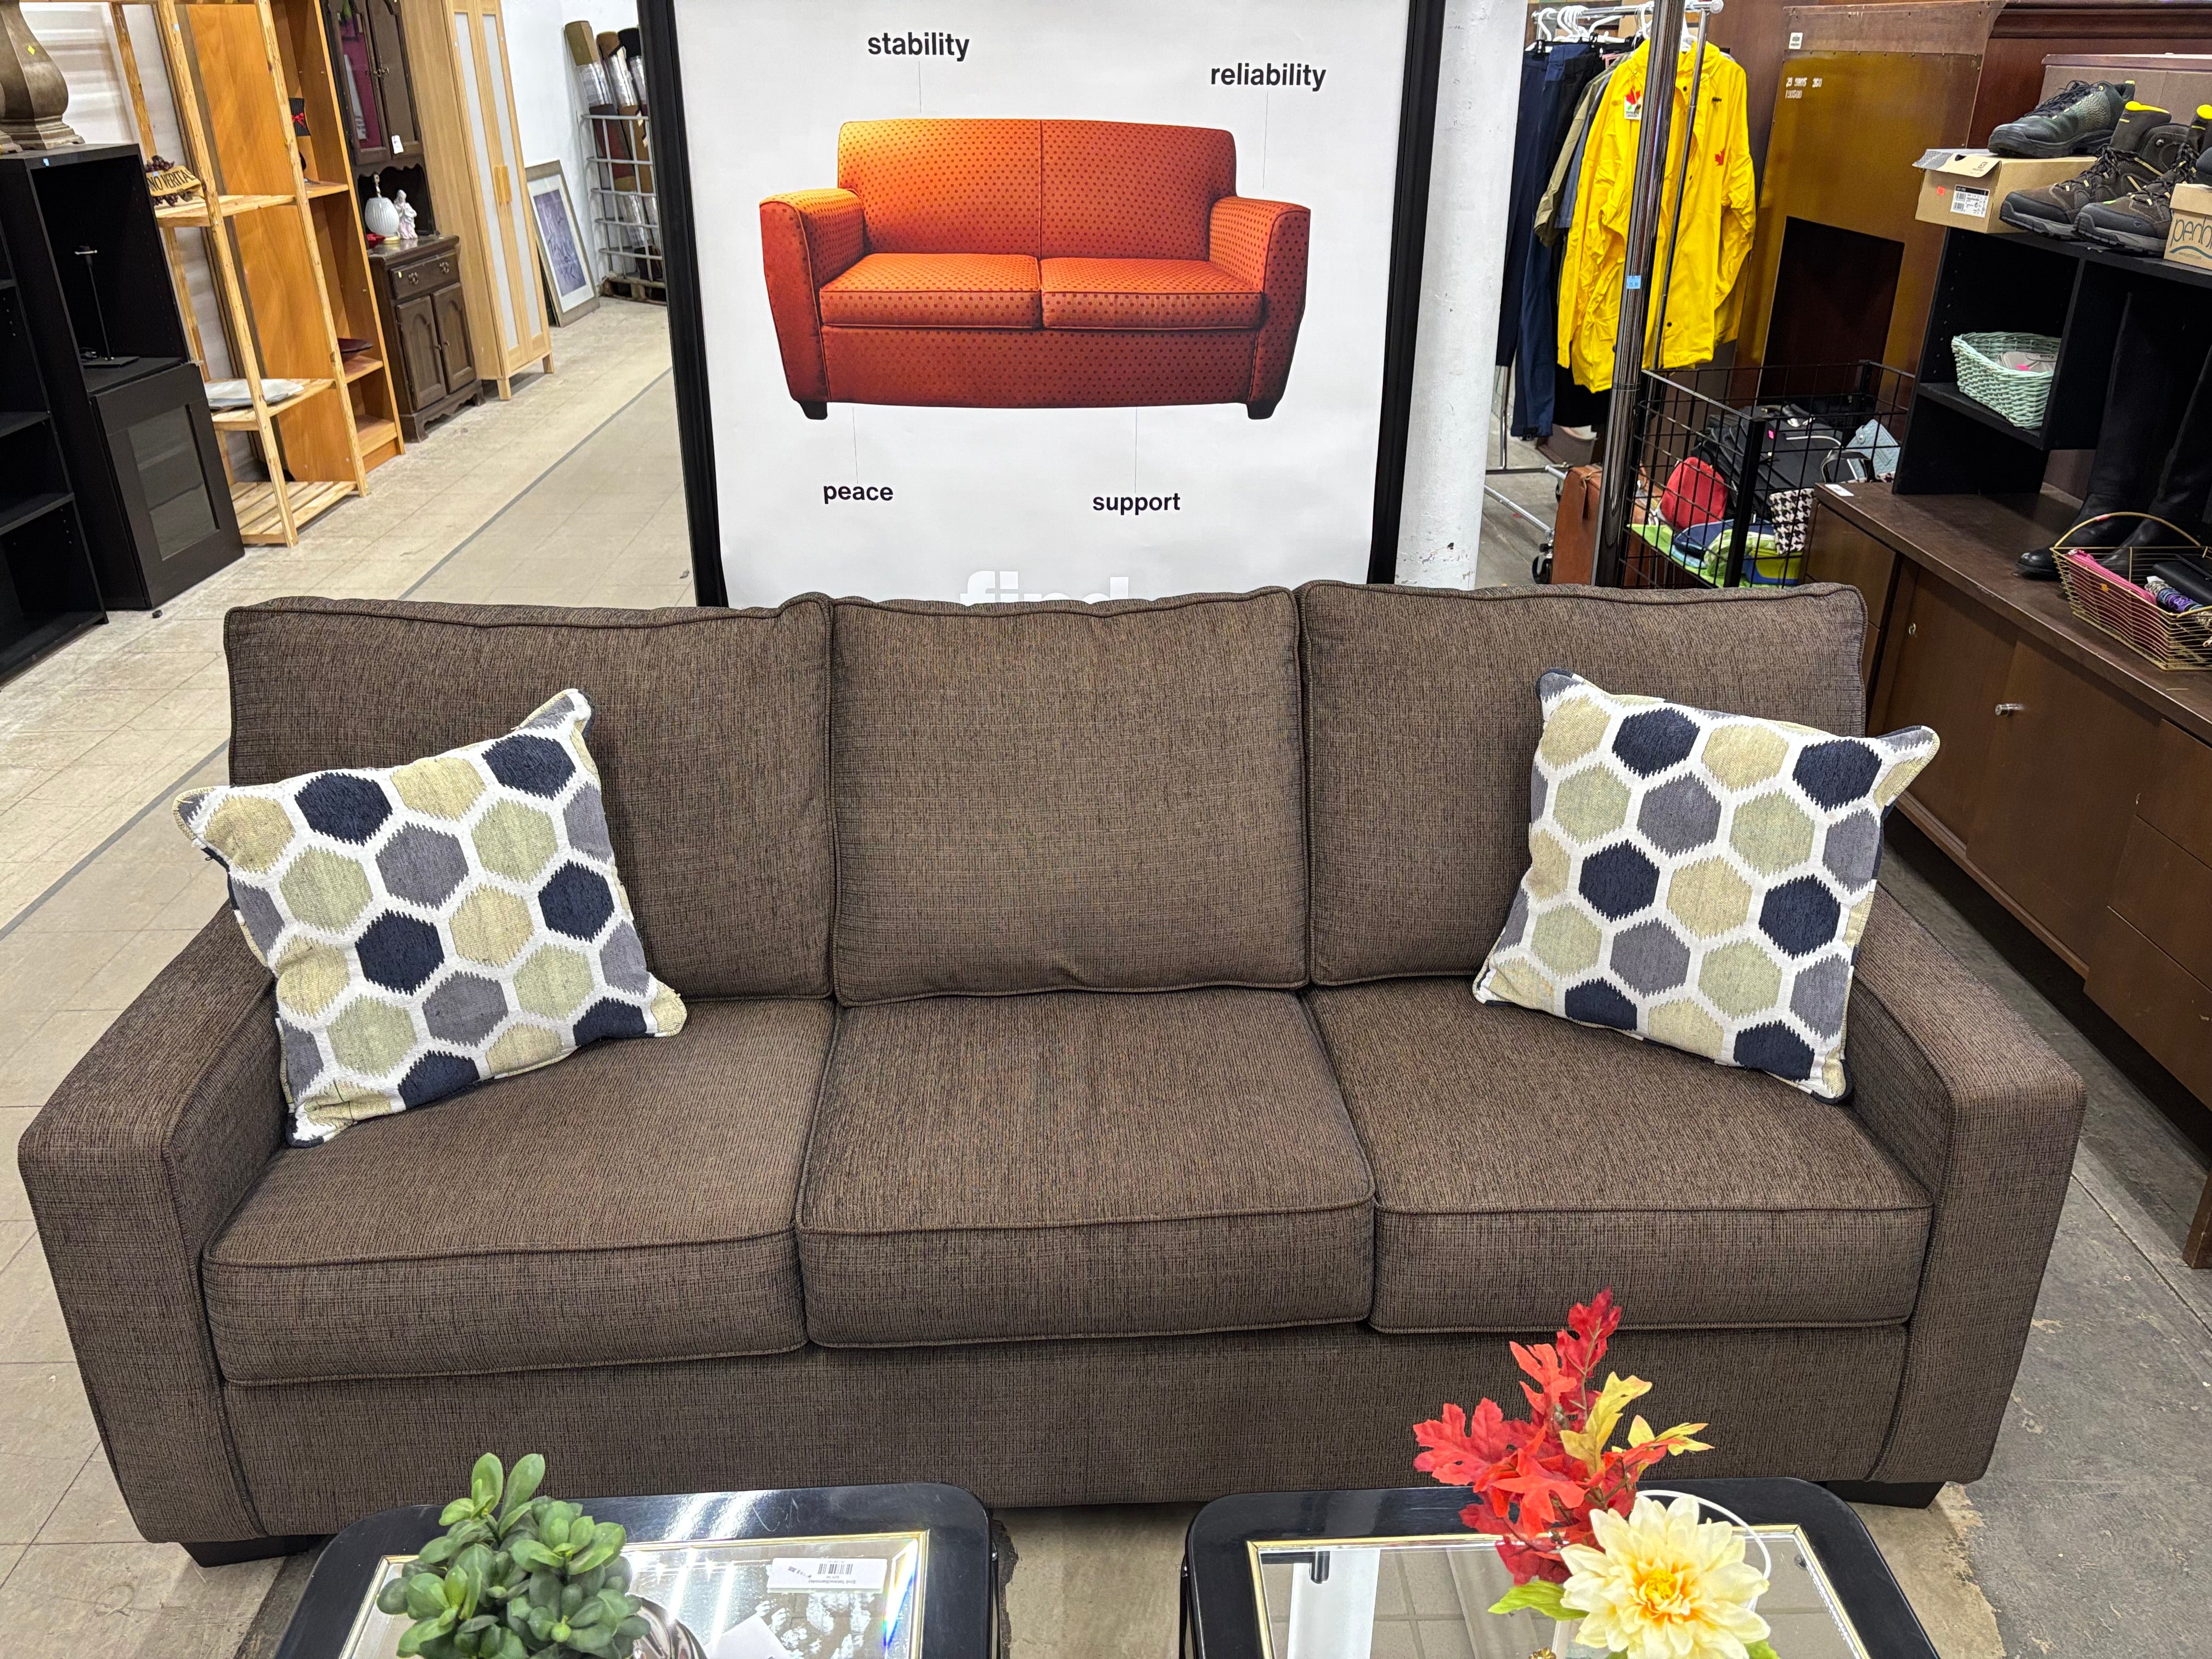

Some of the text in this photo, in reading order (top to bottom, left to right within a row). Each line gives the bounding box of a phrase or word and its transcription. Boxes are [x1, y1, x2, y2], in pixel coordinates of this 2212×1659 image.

[868, 32, 970, 62] stability
[1211, 63, 1327, 92] reliability
[823, 486, 894, 505] peace
[1093, 493, 1181, 516] support
